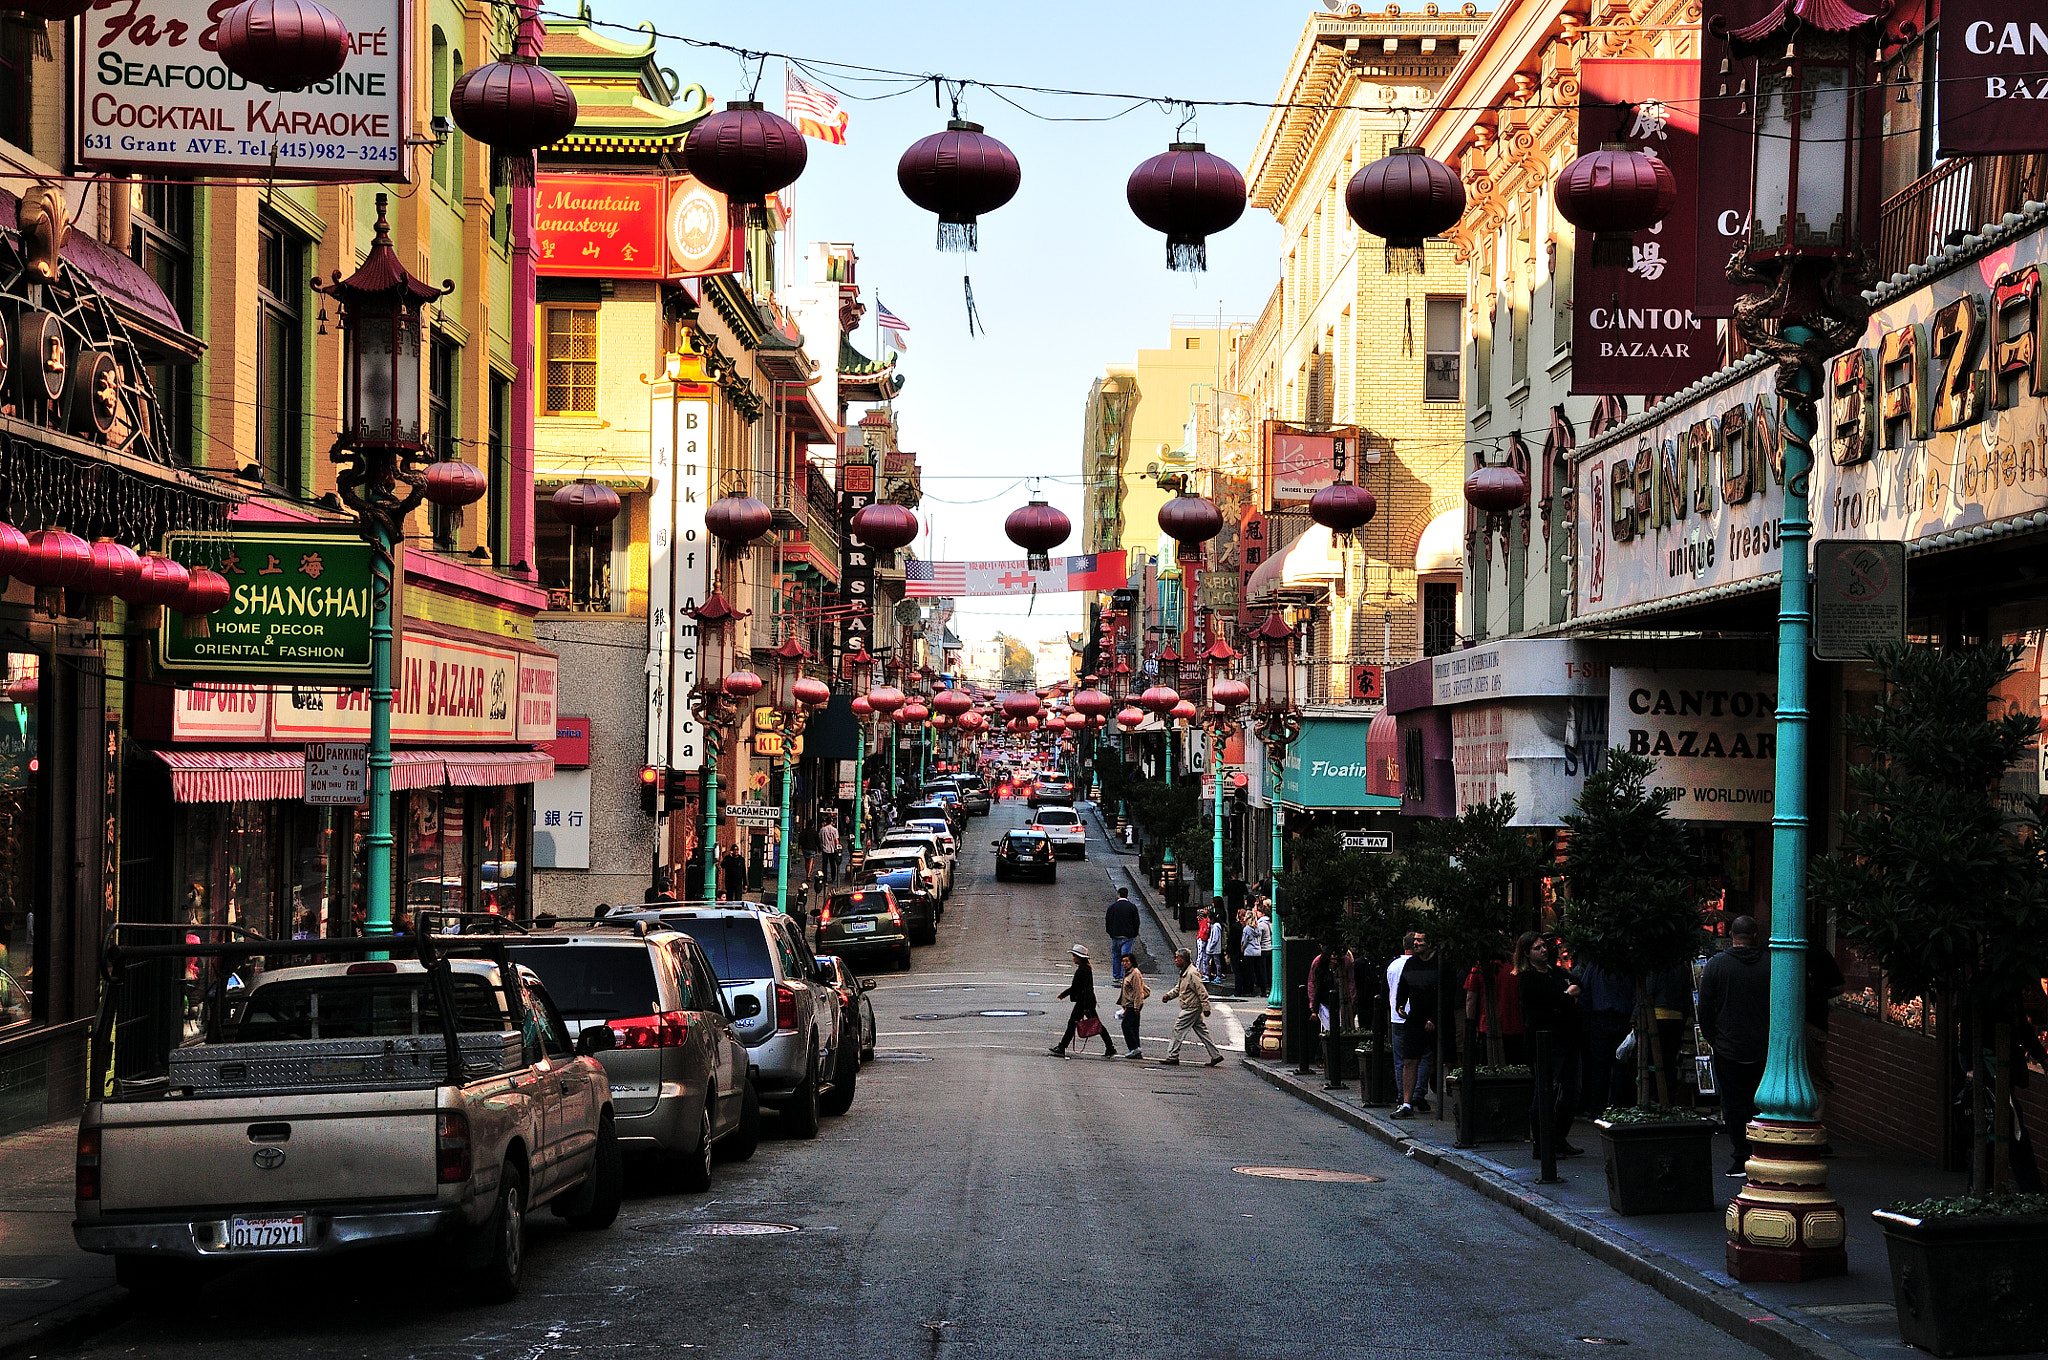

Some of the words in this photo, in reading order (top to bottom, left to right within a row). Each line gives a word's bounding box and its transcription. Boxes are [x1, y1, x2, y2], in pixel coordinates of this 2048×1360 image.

[95, 0, 188, 48] Far
[347, 27, 388, 56] AFÉ
[1965, 21, 2048, 55] CAN
[1985, 77, 2048, 99] BAZ
[92, 93, 235, 132] COCKTAIL
[247, 100, 389, 138] KARAOKE
[84, 134, 112, 150] 631
[121, 136, 177, 153] Grant
[186, 138, 233, 155] AVE.
[549, 191, 641, 212] Mountain
[1589, 308, 1701, 330] CANTON
[1600, 342, 1691, 359] BAZAAR
[1831, 263, 2048, 466] BAZA
[685, 413, 698, 503] Bank
[1280, 438, 1330, 476] Kan's
[1833, 486, 1881, 535] from
[1902, 466, 1940, 514] the
[1965, 432, 2048, 497] orient
[685, 529, 697, 569] of
[1669, 535, 1715, 580] unique
[1729, 516, 1783, 563] treasu
[234, 584, 367, 618] SHANGHAI
[216, 623, 261, 634] HOME
[270, 625, 324, 636] DECOR
[264, 634, 274, 645] &
[194, 644, 269, 656] ORIENTAL
[279, 646, 344, 658] FASHION
[681, 597, 698, 757] America
[1356, 669, 1375, 696] 家
[427, 661, 484, 718] BAZAAR
[1628, 688, 1777, 718] CANTON
[308, 744, 323, 760] NO
[327, 748, 364, 760] PARKING
[1628, 730, 1776, 759] BAZAAR
[311, 764, 318, 776] 2
[343, 764, 349, 776] 6
[1311, 761, 1367, 778] Floatin
[311, 780, 326, 790] MON
[346, 780, 358, 790] FRI
[1694, 788, 1774, 804] WORLDWID
[726, 806, 779, 817] SACRAMENTO
[1346, 837, 1364, 846] ONE
[1366, 837, 1385, 847] WAY
[247, 1218, 290, 1227] California
[236, 1226, 300, 1246] 01779Y1
